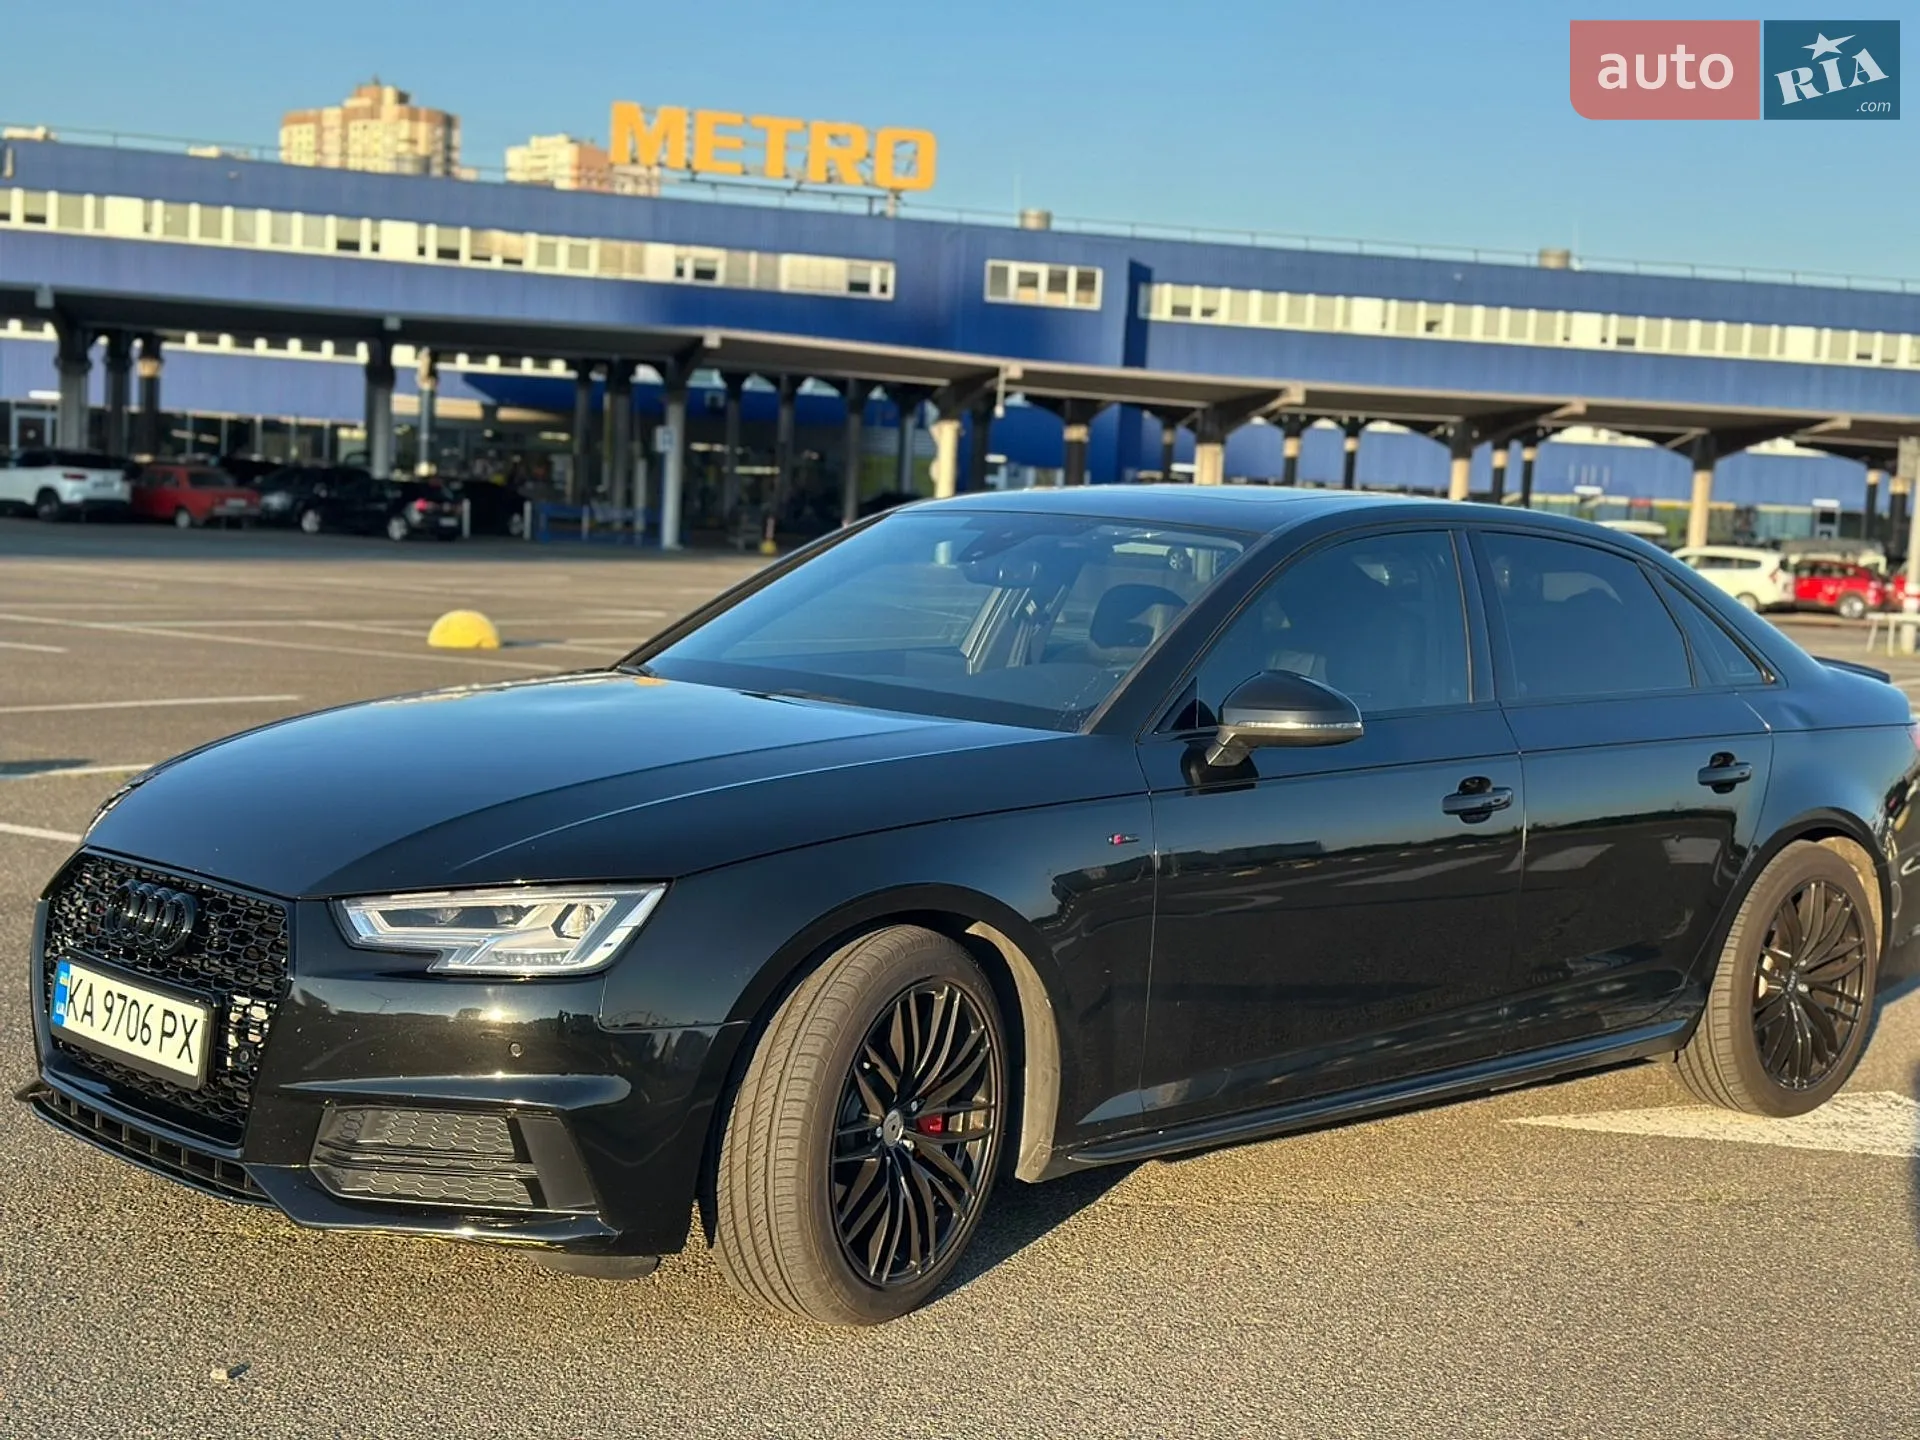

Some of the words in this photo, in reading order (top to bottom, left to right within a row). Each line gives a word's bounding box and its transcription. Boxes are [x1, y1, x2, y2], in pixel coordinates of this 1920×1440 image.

[610, 100, 937, 191] METRO
[67, 975, 94, 1027] KA
[102, 990, 153, 1046] 9706
[159, 1008, 198, 1064] PX
